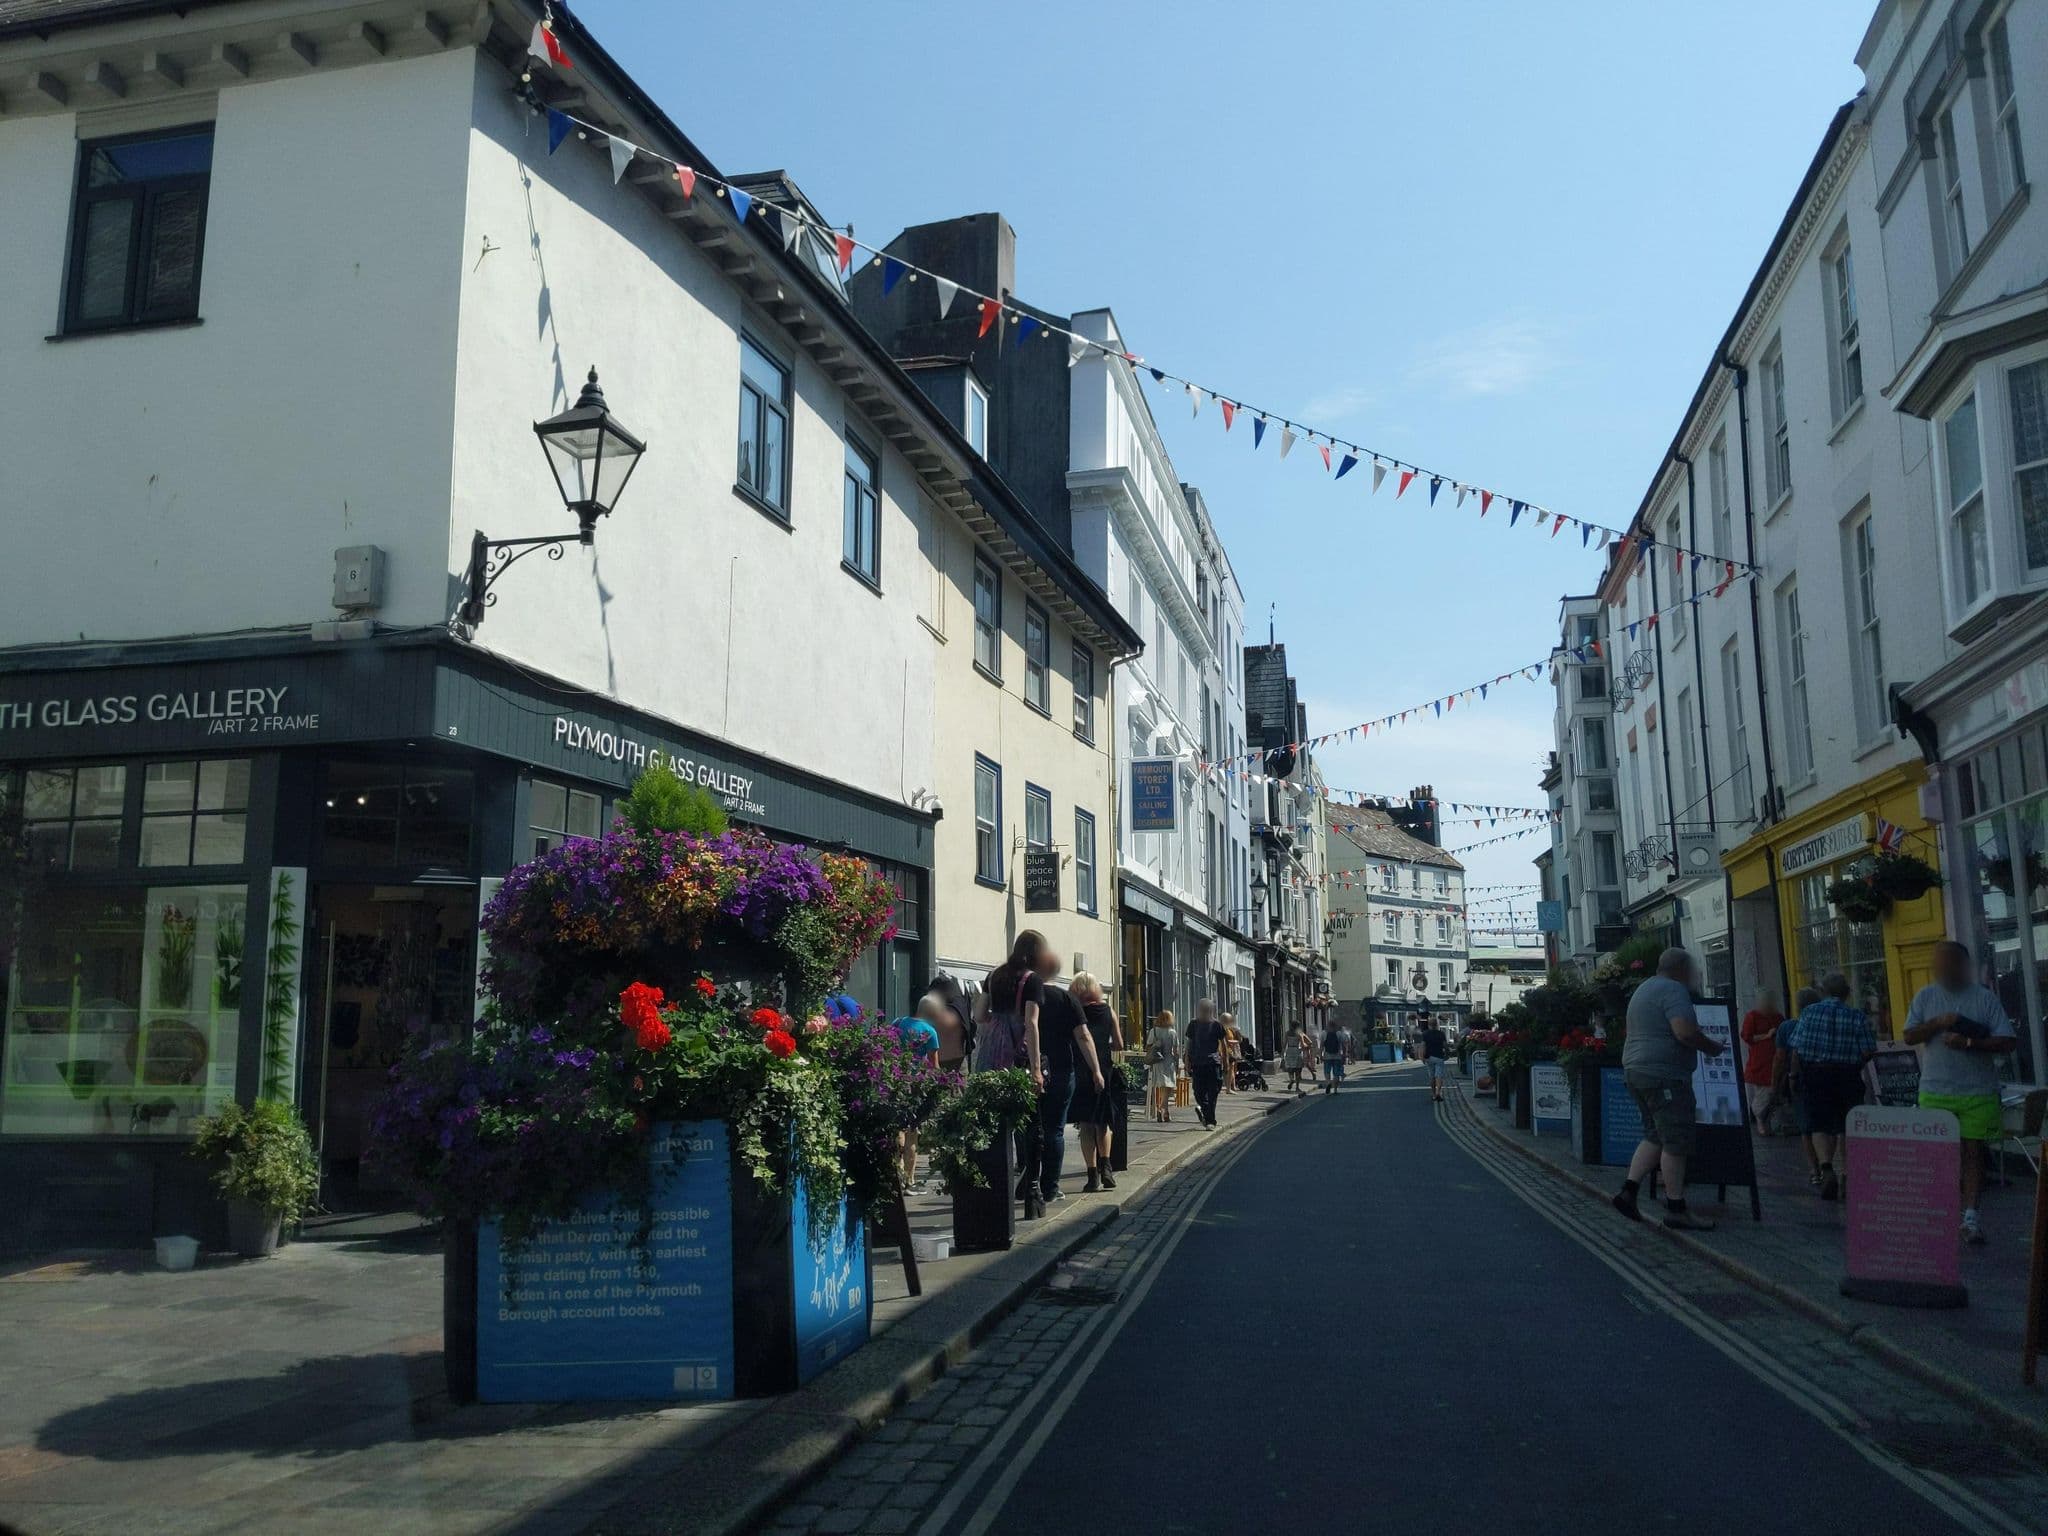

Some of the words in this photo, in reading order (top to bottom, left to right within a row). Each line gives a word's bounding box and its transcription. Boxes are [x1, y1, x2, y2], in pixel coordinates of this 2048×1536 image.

[41, 696, 138, 727] GLASS
[147, 686, 289, 720] GALLERY
[208, 718, 245, 736] /ART
[249, 717, 258, 732] 2
[263, 714, 319, 731] FRAME
[448, 726, 458, 736] 23
[555, 716, 645, 768] PLYMOUTH
[697, 764, 753, 800] GALLERY
[1137, 775, 1168, 785] STORES
[739, 800, 744, 810] 2
[744, 799, 766, 816] FRAME
[1026, 855, 1046, 865] blue
[1026, 867, 1053, 877] peace
[1026, 877, 1057, 889] gallery
[1330, 917, 1353, 929] NAVY
[1854, 1119, 1908, 1134] Flower
[676, 1226, 698, 1239] the
[555, 1249, 594, 1265] pasty,
[598, 1248, 627, 1261] with
[655, 1245, 707, 1260] earliest
[543, 1268, 586, 1283] dating
[589, 1266, 621, 1281] from
[548, 1287, 561, 1301] in
[564, 1288, 591, 1301] one
[593, 1285, 608, 1299] of
[610, 1285, 633, 1299] the
[498, 1304, 557, 1323] Borough
[561, 1305, 615, 1320] account
